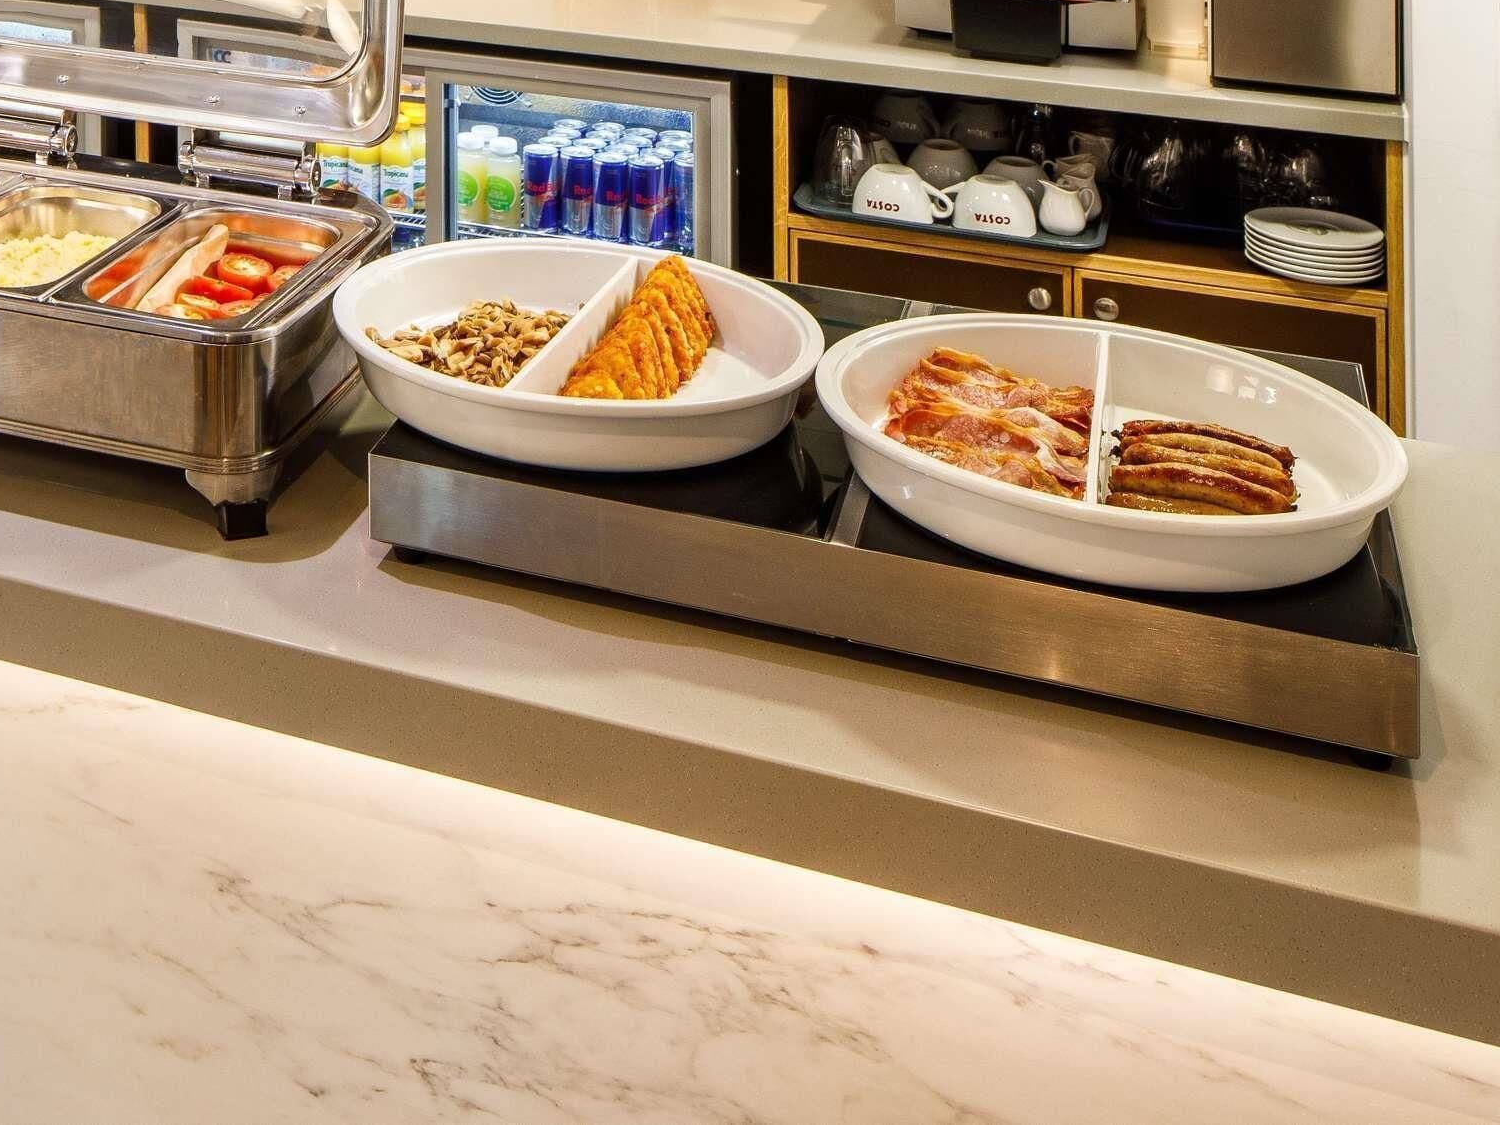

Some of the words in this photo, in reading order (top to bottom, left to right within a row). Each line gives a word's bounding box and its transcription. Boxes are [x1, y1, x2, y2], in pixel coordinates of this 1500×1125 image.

[323, 159, 348, 169] Tropicana
[383, 168, 409, 178] Tropicana
[866, 198, 900, 213] COSTA
[974, 212, 1011, 225] COSTA
